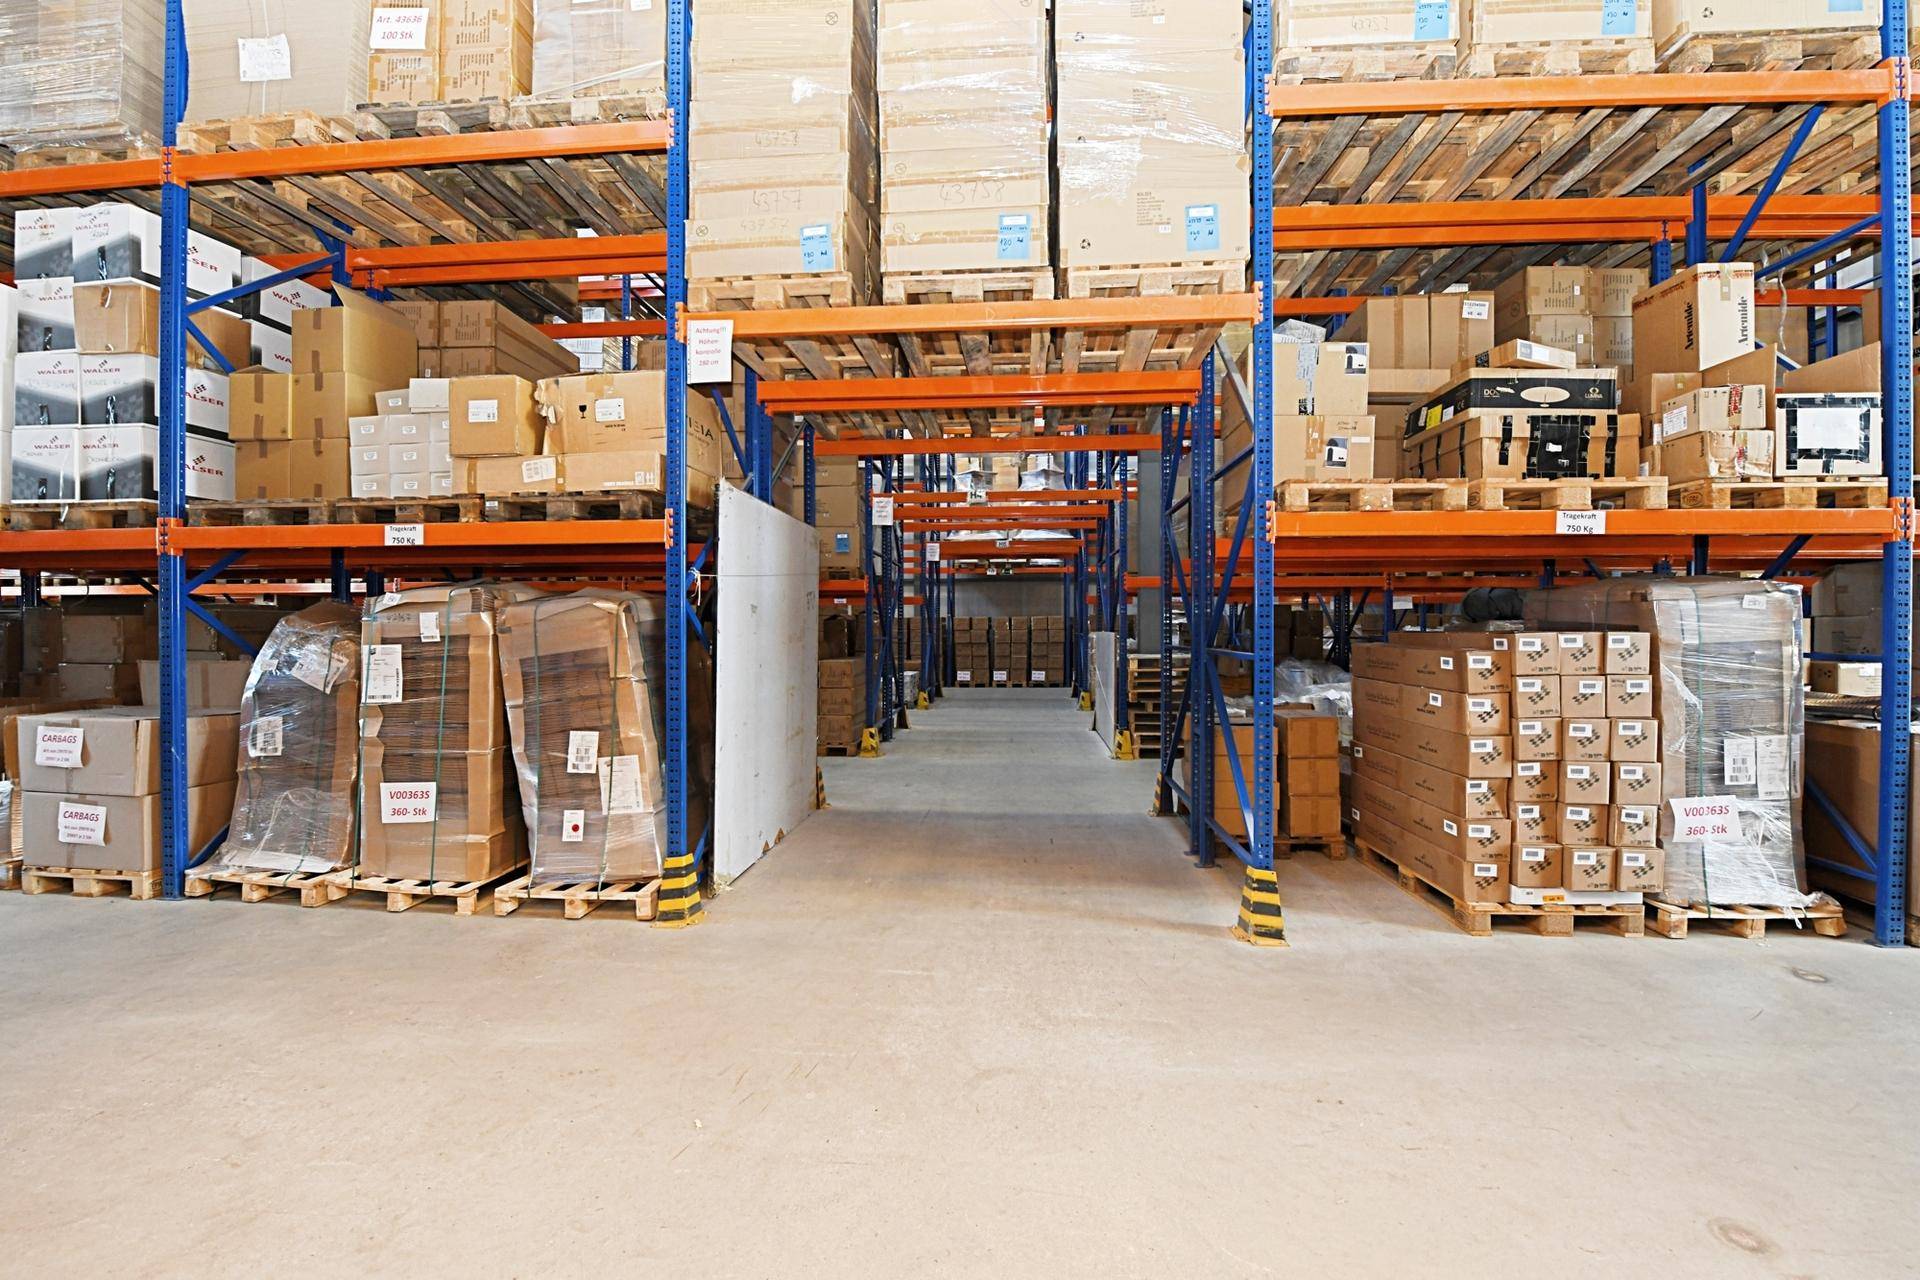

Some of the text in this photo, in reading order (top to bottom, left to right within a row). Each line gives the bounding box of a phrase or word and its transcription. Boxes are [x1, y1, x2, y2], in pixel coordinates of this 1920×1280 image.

[381, 30, 414, 40] 100 Stk
[75, 222, 109, 231] WALSER
[1738, 296, 1748, 345] Artemide
[1684, 302, 1694, 350] Artemide
[1563, 512, 1597, 520] Tragekraft
[1583, 525, 1594, 534] Kg
[406, 537, 416, 545] Kg
[42, 734, 78, 744] CARBAGS
[63, 810, 100, 822] CARBAGS
[391, 807, 427, 816] 360- Stk
[1686, 824, 1727, 836] 360- Stk
